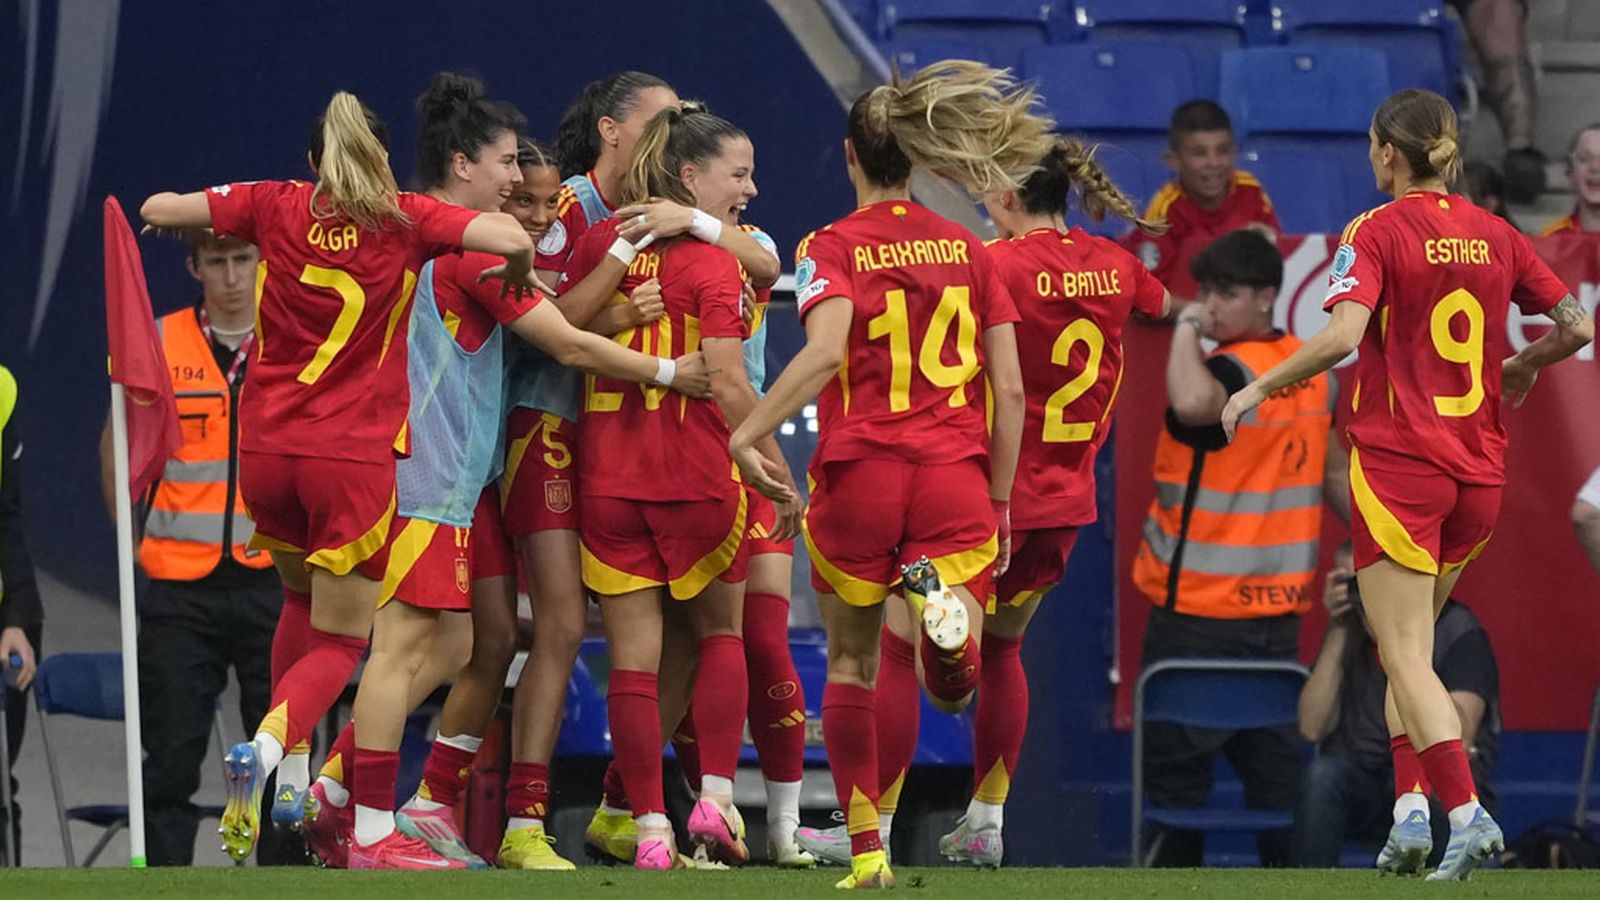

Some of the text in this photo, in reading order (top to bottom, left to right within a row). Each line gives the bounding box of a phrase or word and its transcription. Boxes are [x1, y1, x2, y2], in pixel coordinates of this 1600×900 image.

[307, 222, 358, 251] OLGA
[1425, 238, 1490, 265] ESTHER
[1037, 269, 1121, 297] O. BATLLE
[297, 264, 366, 386] 7
[173, 366, 204, 380] 194
[868, 286, 982, 413] 14
[1430, 288, 1485, 417] 9
[1042, 318, 1105, 443] 2
[542, 422, 572, 469] 5
